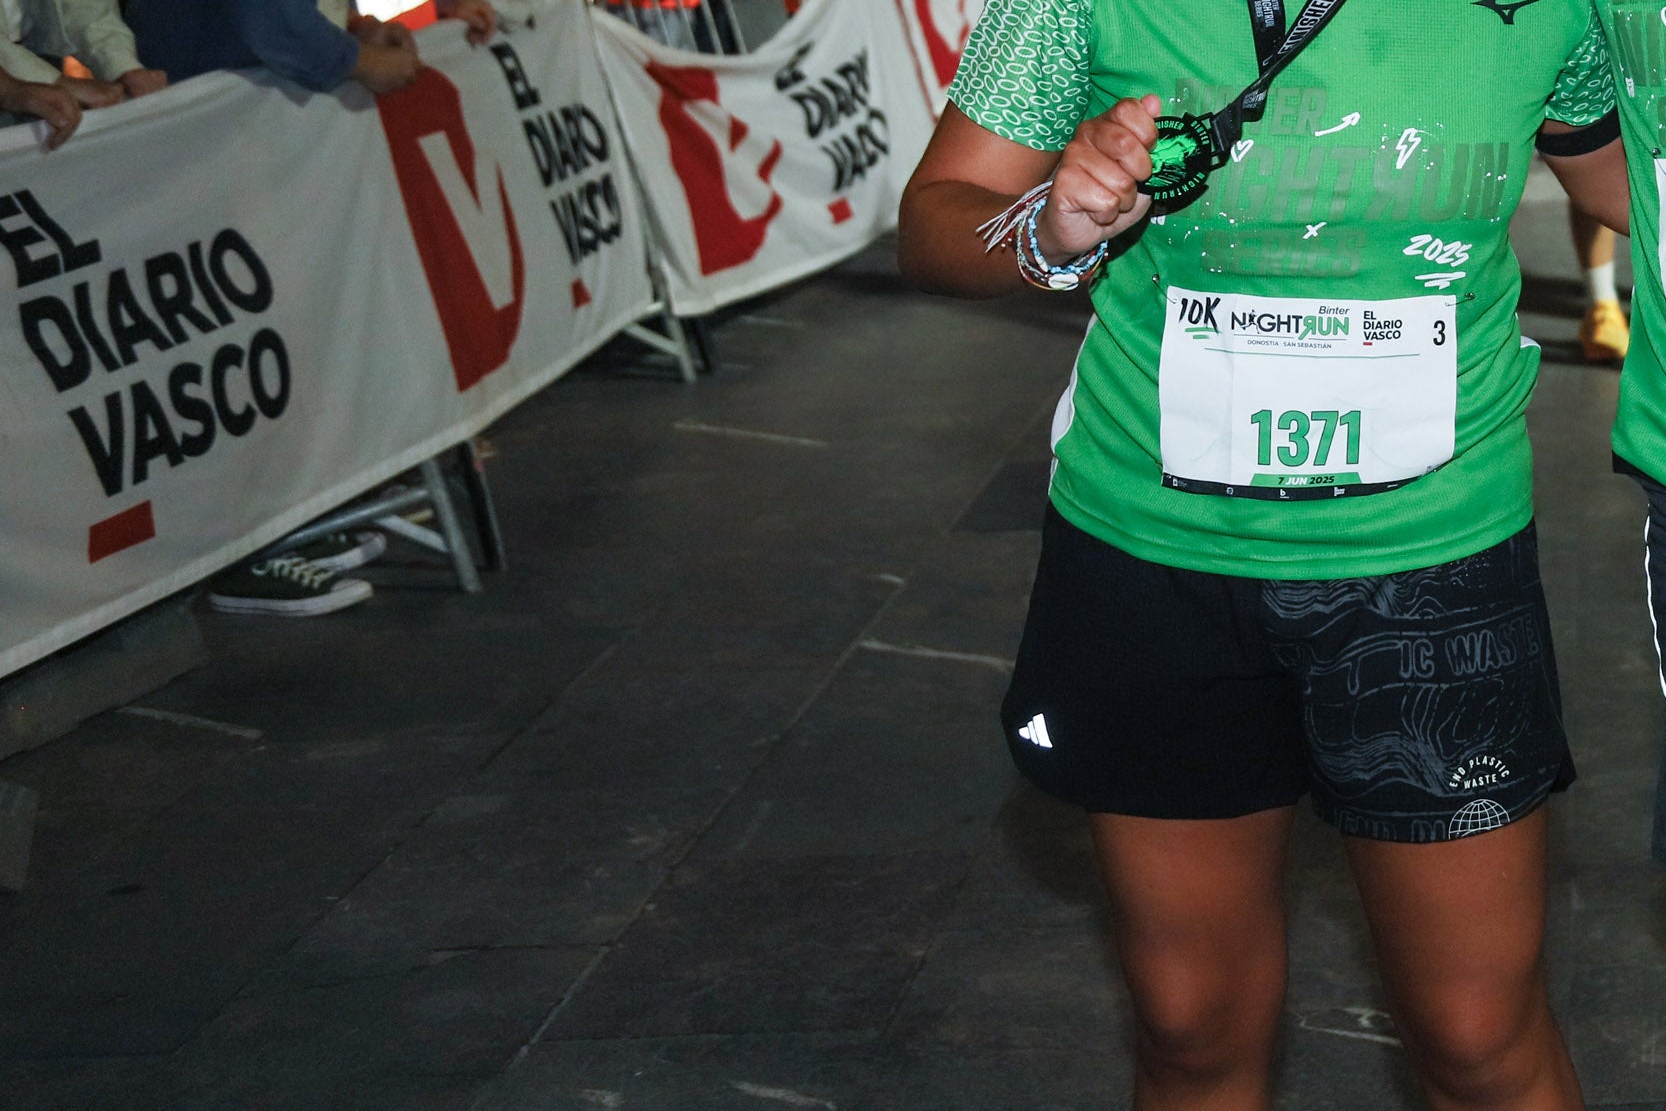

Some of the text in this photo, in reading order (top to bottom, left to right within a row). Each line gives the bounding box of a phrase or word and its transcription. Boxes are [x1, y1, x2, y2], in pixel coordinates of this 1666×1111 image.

[0, 189, 102, 288] EL
[1402, 234, 1473, 267] 2025
[19, 227, 274, 393] DIARIO
[1178, 296, 1221, 334] 10K
[1318, 305, 1350, 316] Binter
[1363, 310, 1377, 320] EL
[1363, 319, 1403, 330] DIARIO
[1363, 329, 1402, 340] VASCO
[1433, 319, 1446, 346] 3
[1247, 339, 1280, 347] DONOSTIA
[67, 327, 291, 497] VASCO
[1251, 409, 1362, 467] 1371
[1278, 475, 1335, 485] 7 JUN 2025
[1449, 755, 1510, 788] END PLASTIC
[1464, 773, 1497, 789] WASTE
